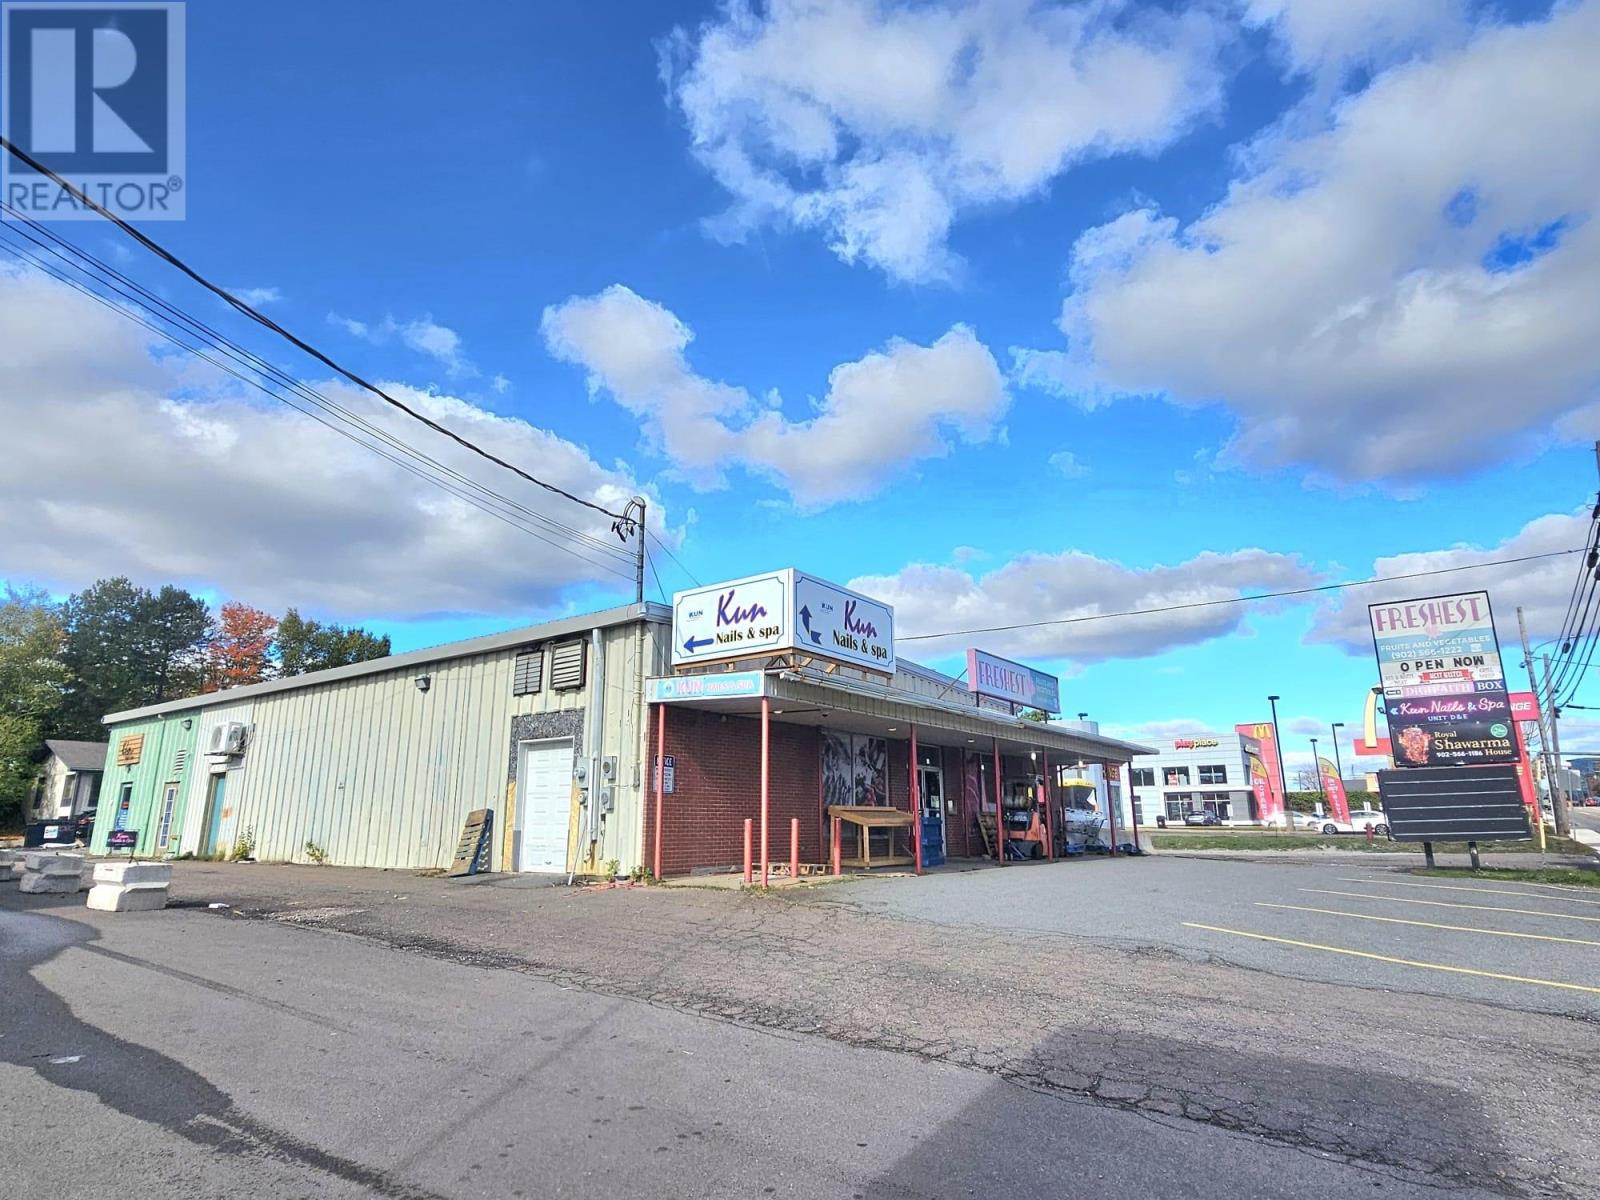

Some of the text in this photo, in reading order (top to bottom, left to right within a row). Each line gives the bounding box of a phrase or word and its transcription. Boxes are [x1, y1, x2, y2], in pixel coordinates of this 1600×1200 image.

[716, 589, 767, 627] Kun
[1375, 597, 1481, 632] FRESHEST
[843, 600, 878, 638] Kun
[715, 624, 780, 646] Nails & spa
[1381, 635, 1491, 652] FRUITS AND VEGETABLES
[832, 629, 888, 660] Nails & spa
[1454, 655, 1485, 667] NOW
[976, 661, 1025, 696] FRESHEST
[1477, 681, 1503, 690] BOX
[1400, 697, 1504, 715] Kun Nails & Spa
[1434, 731, 1457, 739] Royal
[1434, 739, 1511, 750] Shawarma
[1485, 748, 1512, 756] House
